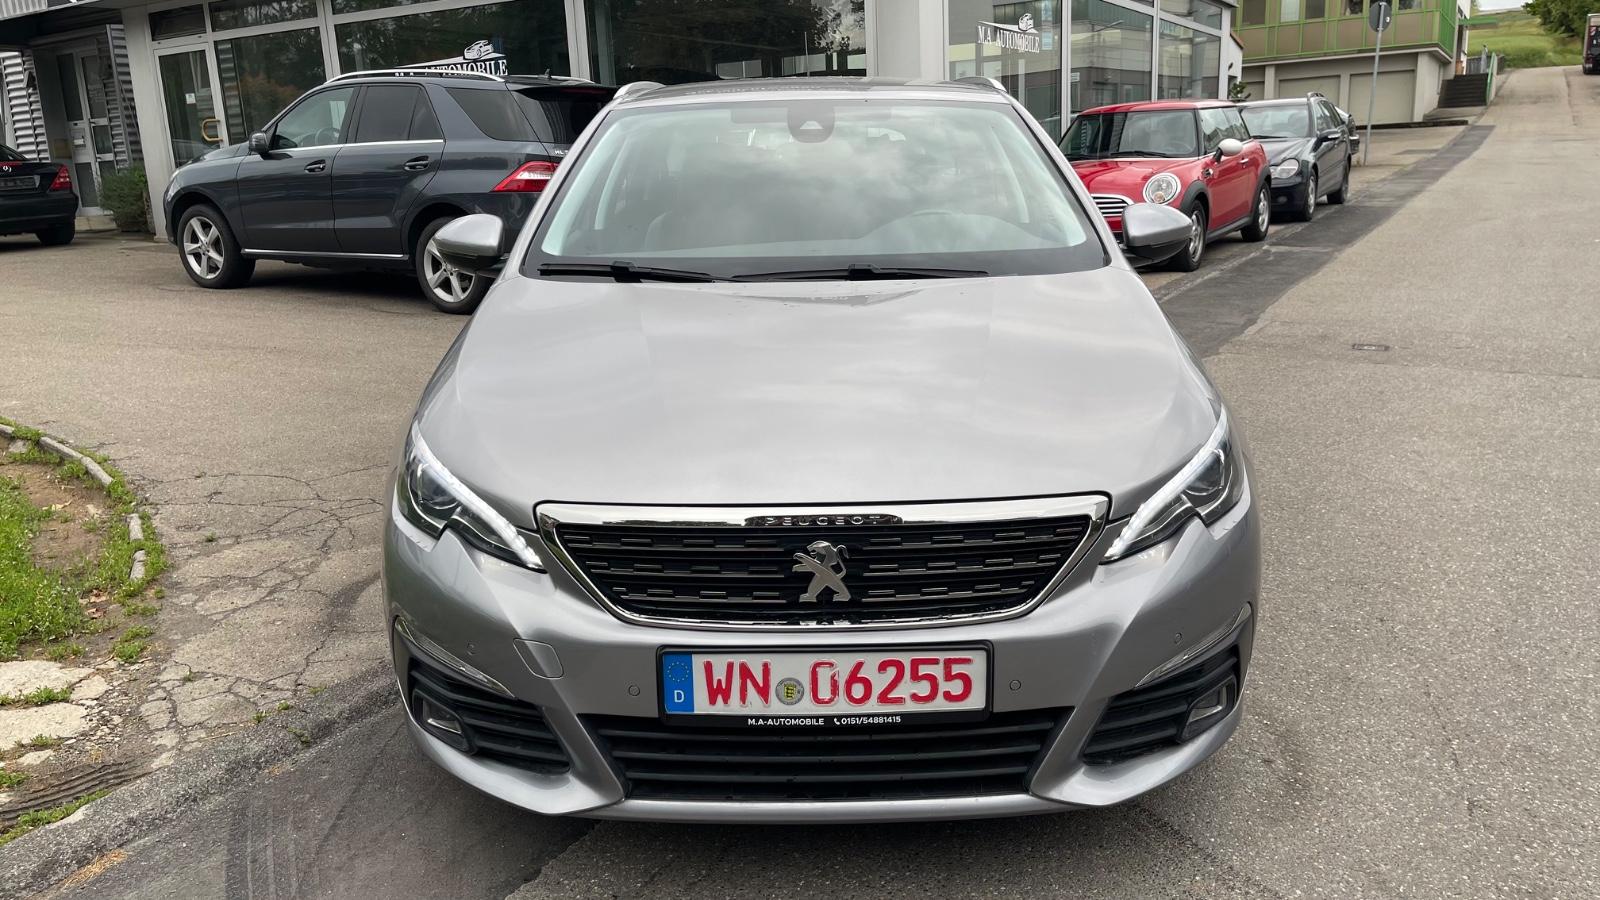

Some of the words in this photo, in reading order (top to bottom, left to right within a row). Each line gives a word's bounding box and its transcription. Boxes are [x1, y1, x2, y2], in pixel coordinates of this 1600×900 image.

[995, 28, 1040, 53] AUTOMOBILE
[764, 516, 881, 526] PEUGEOT
[703, 660, 771, 706] WN
[810, 657, 974, 706] 06255
[674, 690, 685, 703] D
[748, 718, 825, 726] M.A-AUTOMOBILE
[841, 716, 901, 725] 0151/54881415
